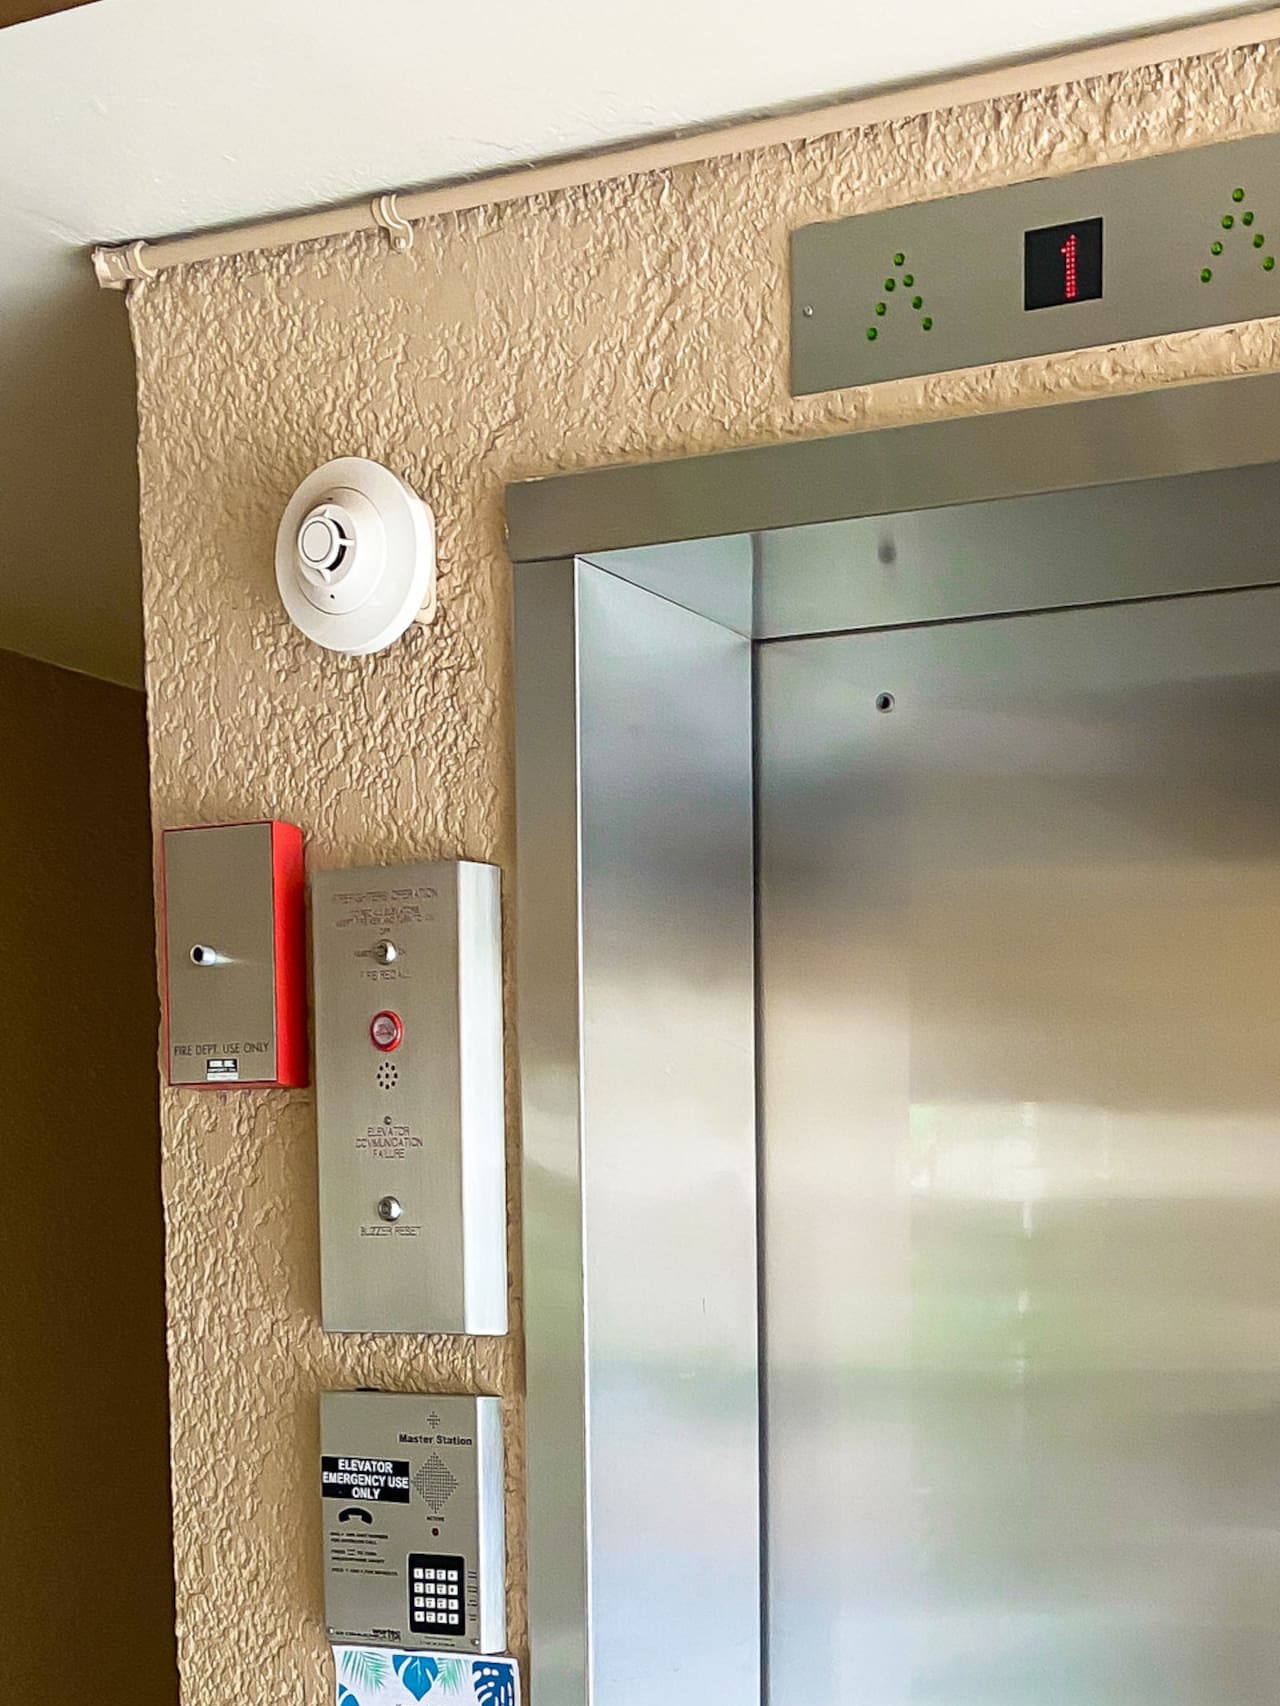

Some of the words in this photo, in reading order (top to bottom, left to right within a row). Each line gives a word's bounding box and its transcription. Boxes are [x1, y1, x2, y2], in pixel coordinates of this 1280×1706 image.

[1060, 233, 1077, 299] 1
[175, 1045, 193, 1056] FIRE
[222, 1043, 240, 1053] USE
[243, 1041, 269, 1053] ONLY
[399, 1434, 434, 1444] Master
[437, 1435, 472, 1446] Station
[338, 1459, 393, 1473] ELEVATOR
[323, 1471, 386, 1486] EMERGENCY
[388, 1476, 409, 1488] USE
[352, 1487, 380, 1499] ONLY
